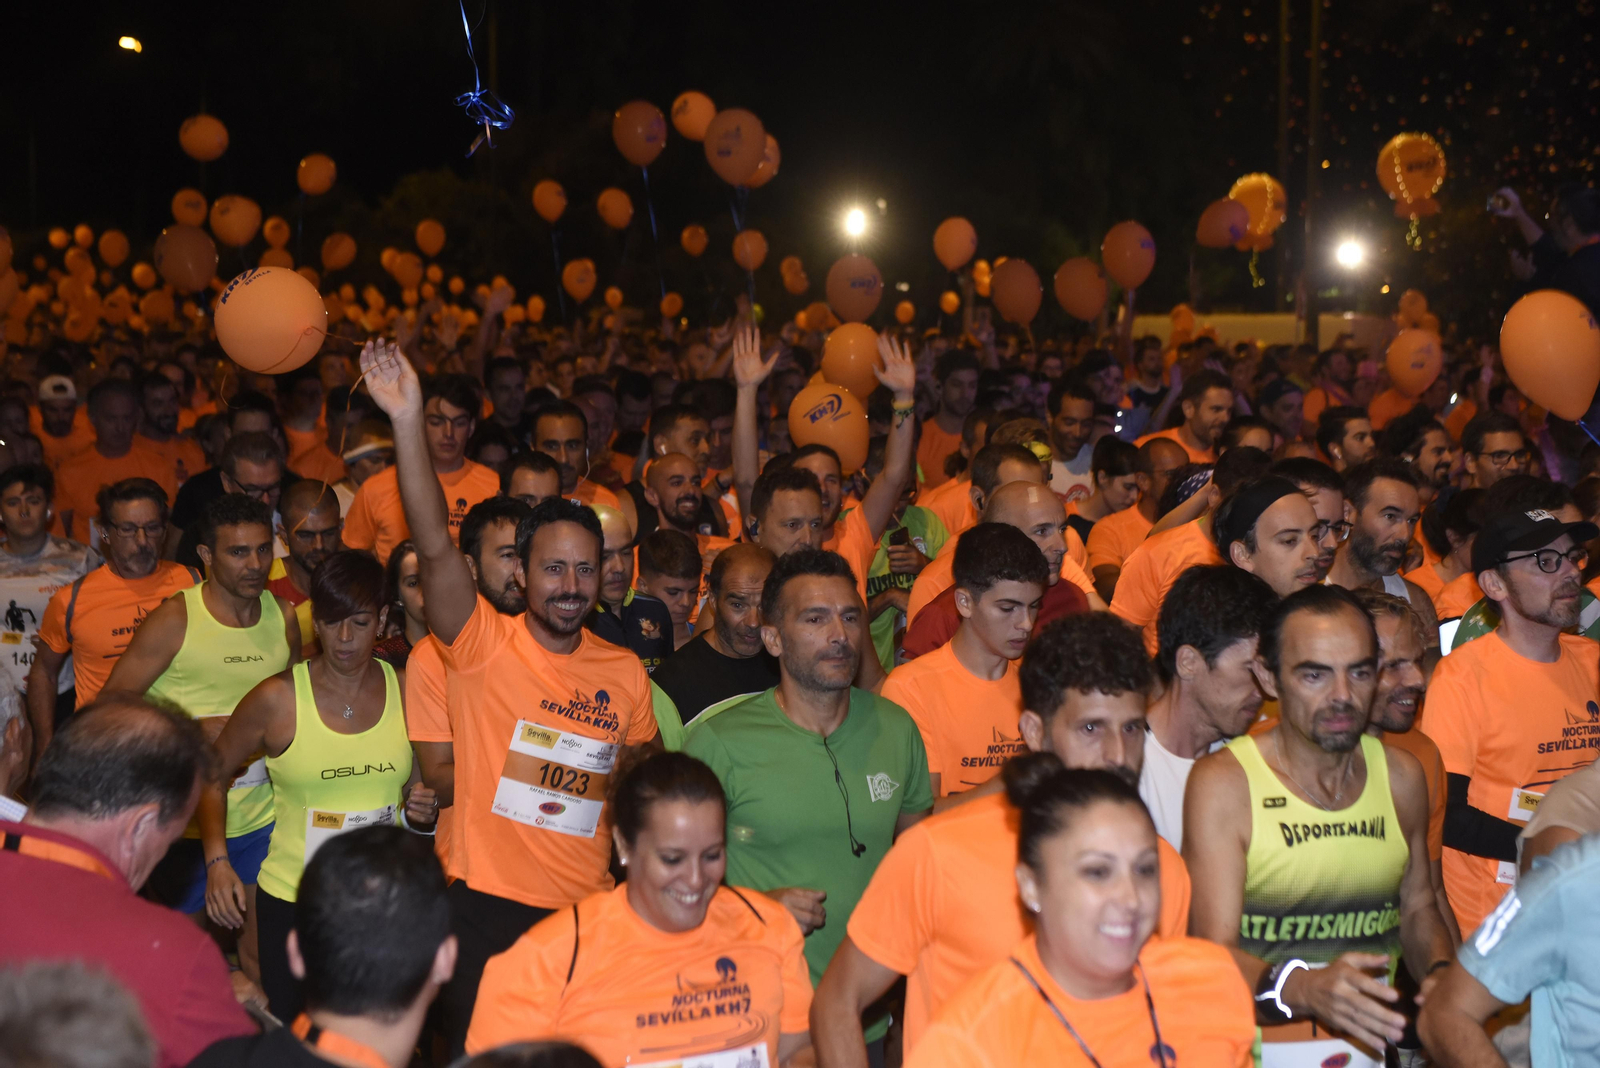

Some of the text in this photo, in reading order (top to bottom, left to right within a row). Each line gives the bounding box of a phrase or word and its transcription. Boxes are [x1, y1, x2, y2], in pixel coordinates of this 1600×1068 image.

[223, 655, 265, 664] OSUNA
[540, 699, 619, 732] SEVILLA KH7
[1537, 739, 1587, 754] SEVILLA
[321, 762, 396, 780] OSUNA
[539, 763, 591, 796] 1023
[1279, 815, 1386, 848] DEPORTEMANIA
[672, 982, 750, 1007] NOCTURNA
[636, 998, 752, 1029] SEVILLA KH7
